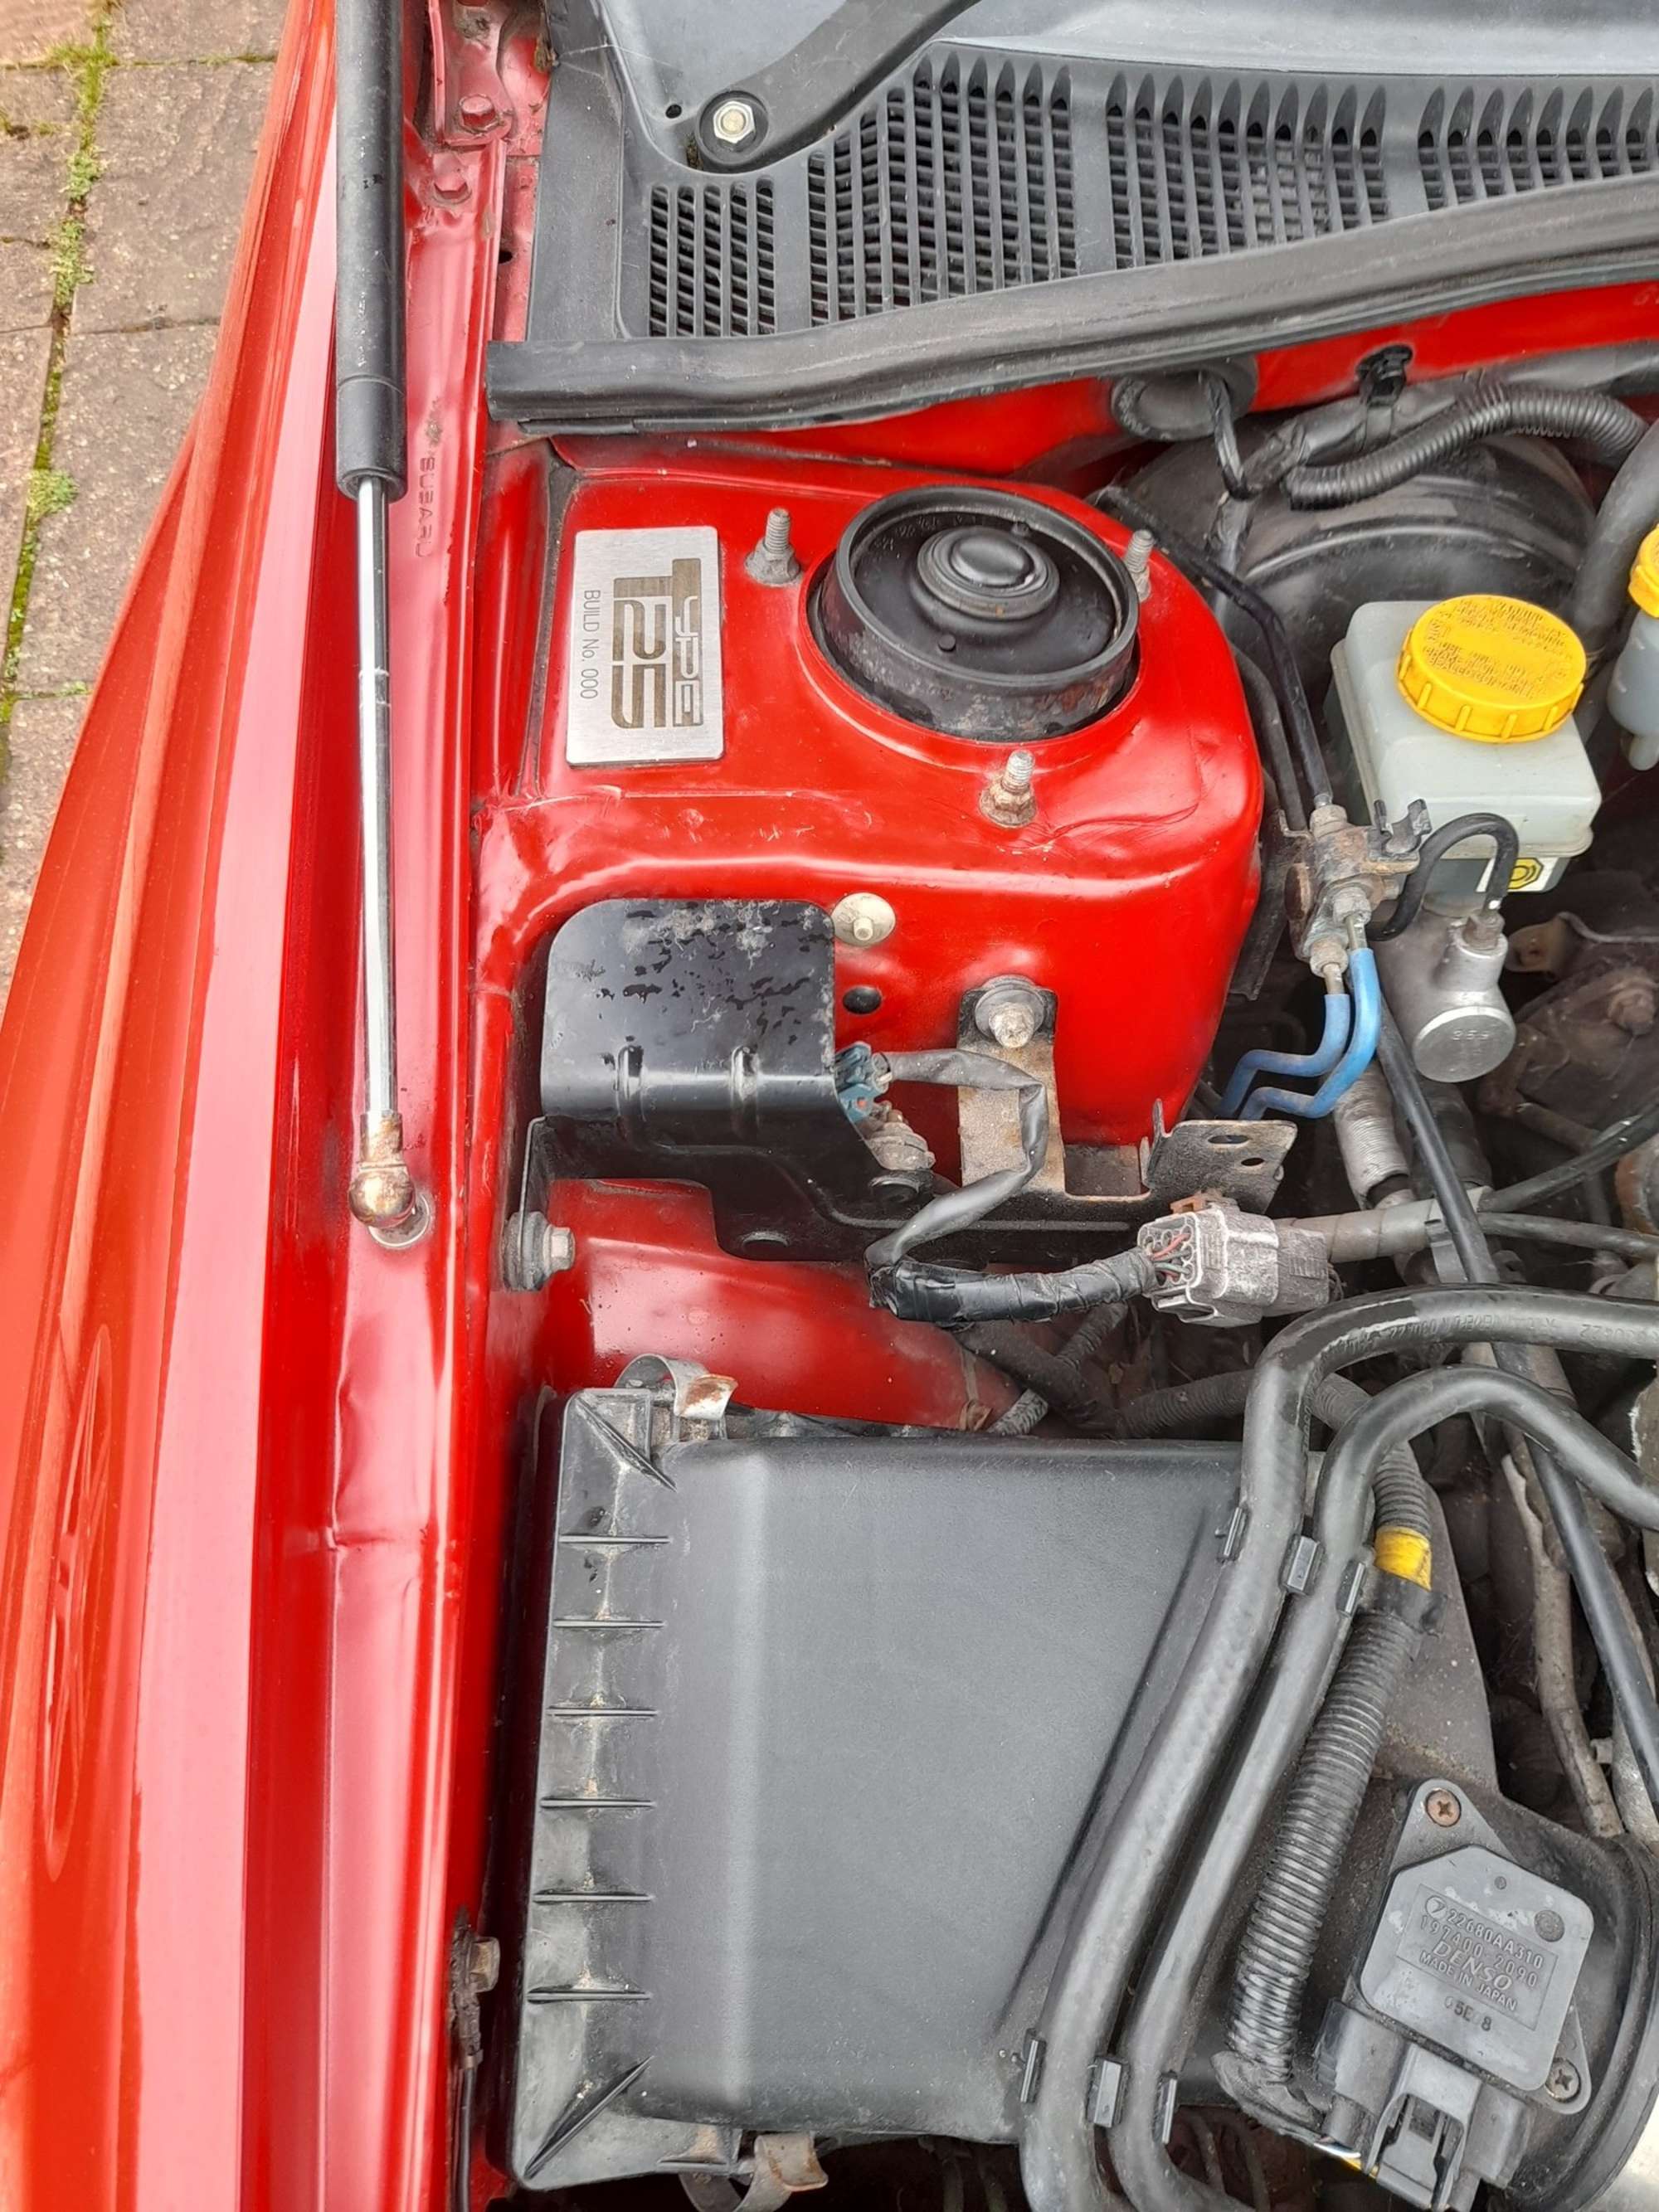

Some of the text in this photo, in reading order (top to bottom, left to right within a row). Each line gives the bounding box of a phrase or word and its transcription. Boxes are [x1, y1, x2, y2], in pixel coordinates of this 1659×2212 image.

[416, 457, 436, 558] SUBARU
[581, 590, 601, 700] BUILD No. 000
[1433, 1940, 1514, 1991] DENSO
[1446, 1908, 1545, 1969] 22680AA310
[1418, 1952, 1519, 2011] MADE IN JAPAN
